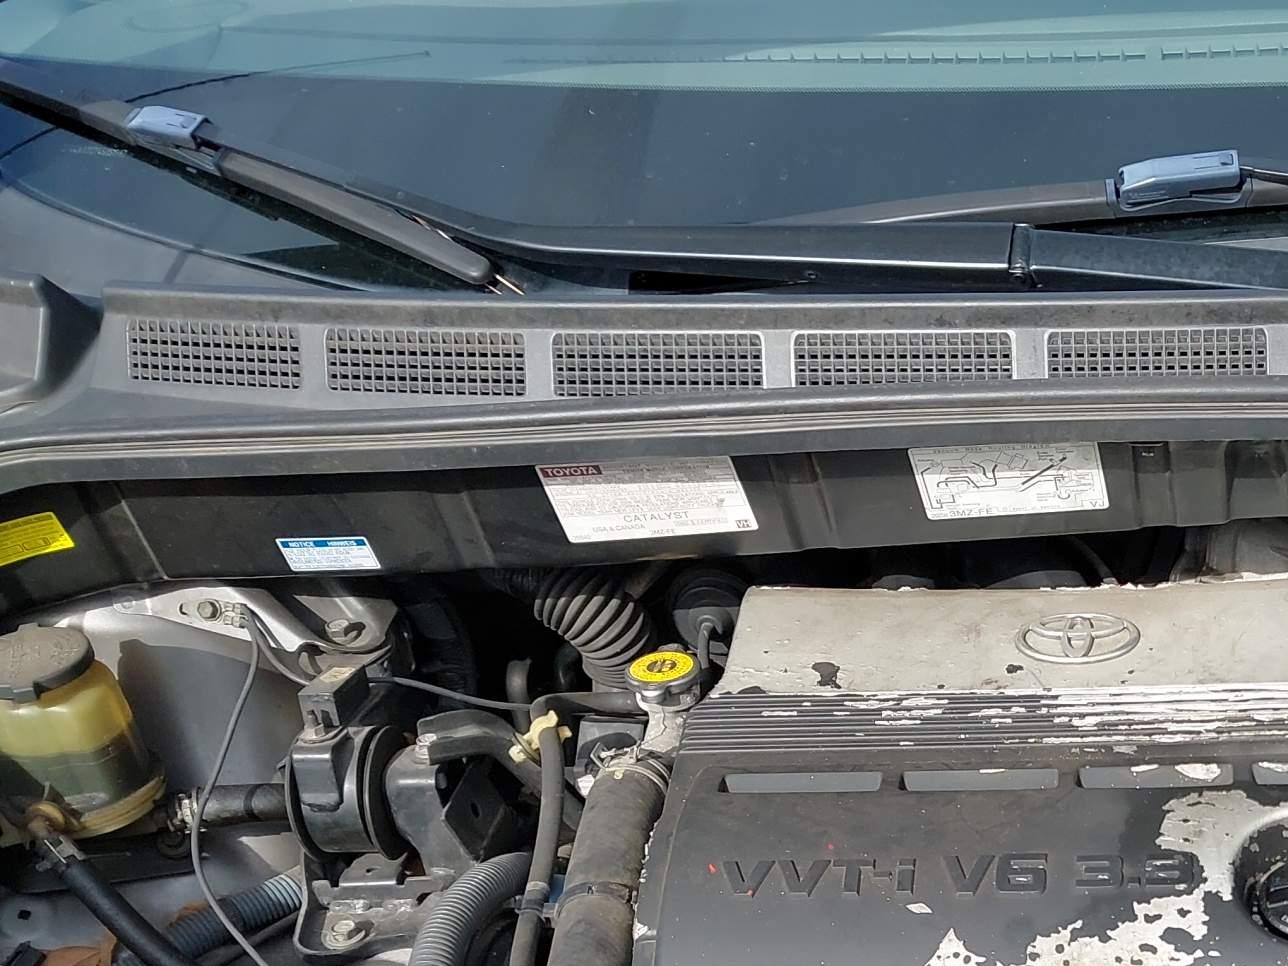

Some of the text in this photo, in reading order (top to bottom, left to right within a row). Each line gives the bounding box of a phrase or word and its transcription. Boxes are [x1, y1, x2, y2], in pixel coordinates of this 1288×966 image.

[545, 466, 598, 477] TOYOTA
[623, 511, 690, 523] CATALYST
[941, 852, 1049, 897] V6
